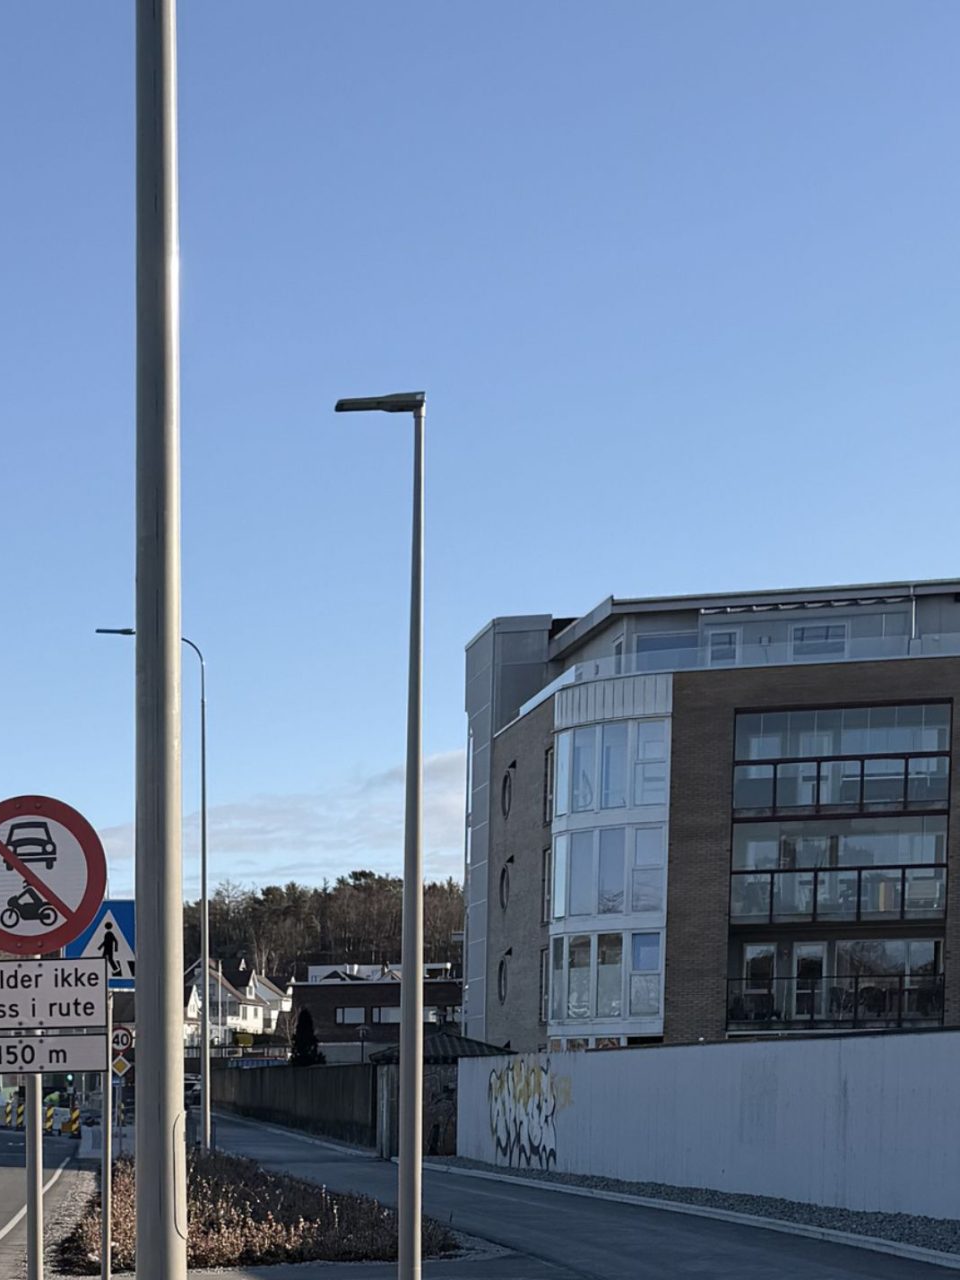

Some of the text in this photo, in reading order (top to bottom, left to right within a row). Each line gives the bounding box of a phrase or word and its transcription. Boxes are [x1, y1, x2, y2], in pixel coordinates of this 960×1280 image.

[54, 967, 100, 988] ikke
[31, 998, 36, 1018] i
[48, 998, 95, 1017] rute
[112, 1033, 129, 1046] 40
[48, 1048, 67, 1064] m
